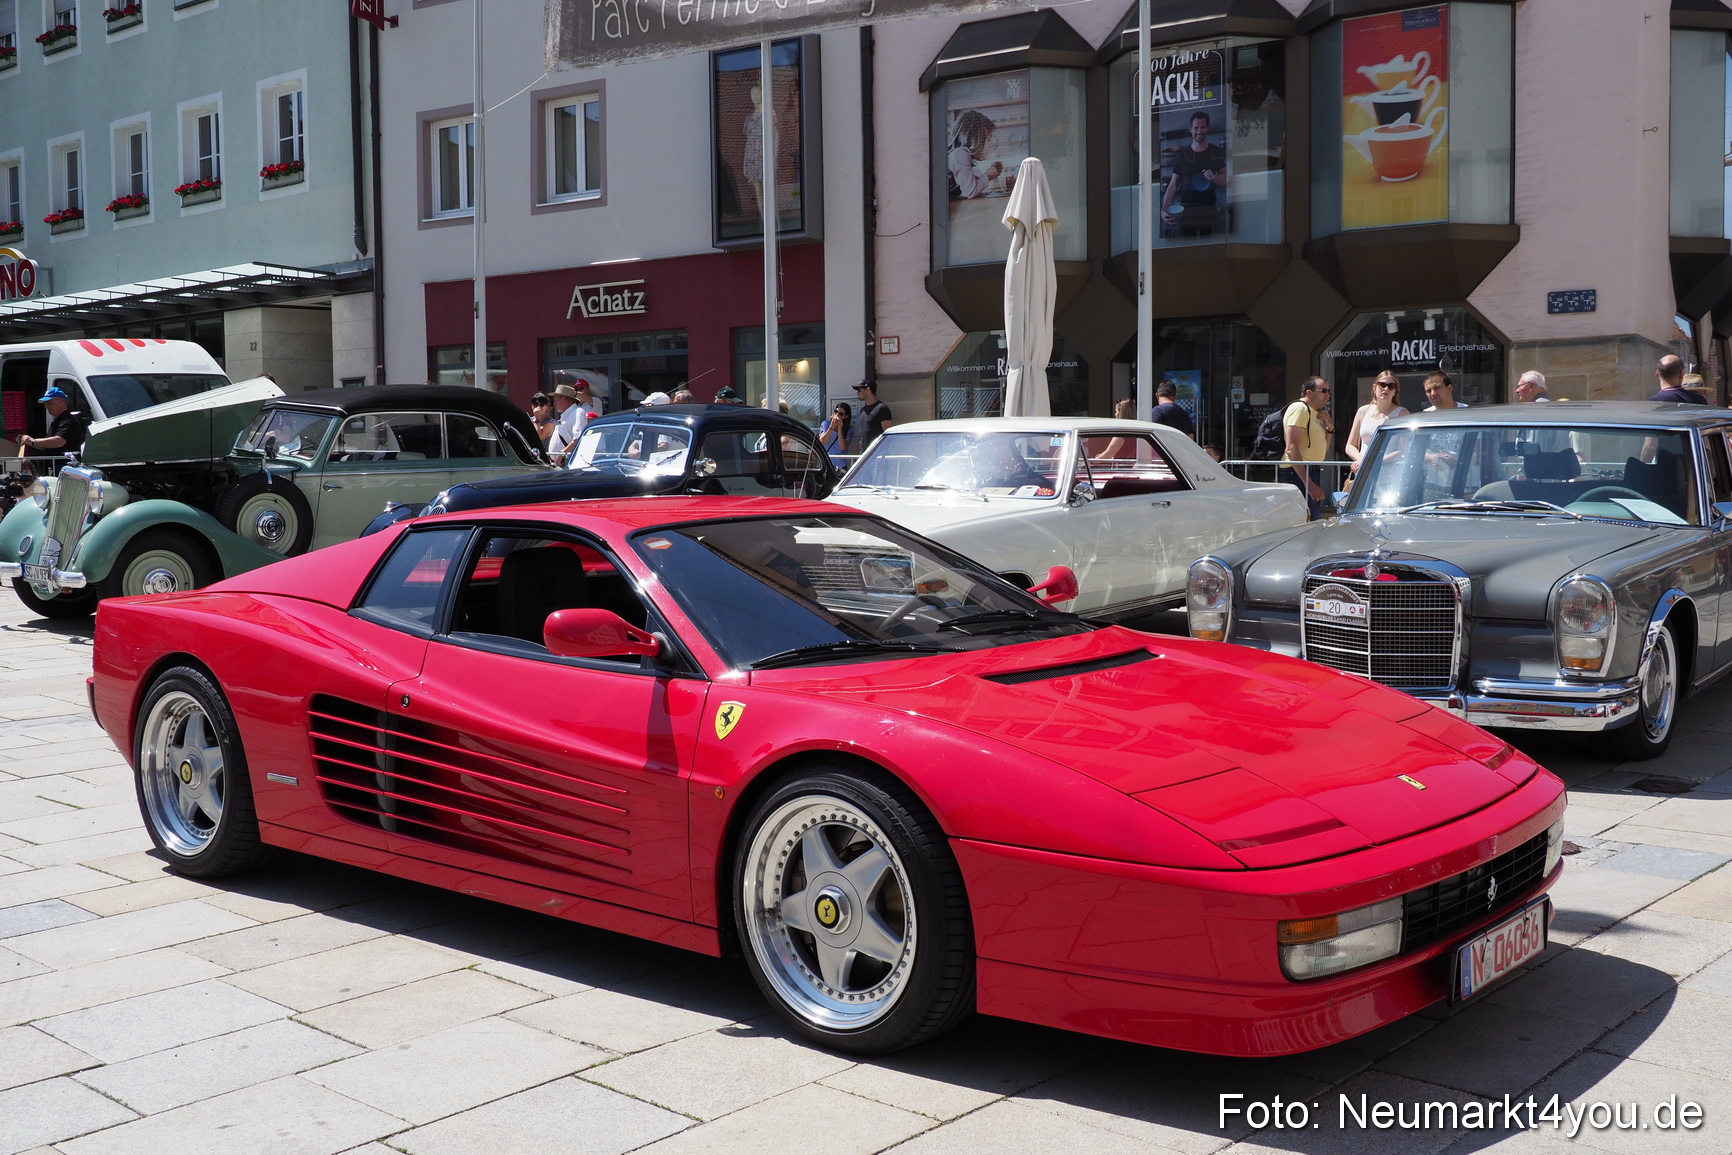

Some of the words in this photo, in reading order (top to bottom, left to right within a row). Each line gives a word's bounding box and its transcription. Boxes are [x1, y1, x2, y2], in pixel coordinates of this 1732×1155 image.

[1151, 58, 1167, 73] 00
[1170, 48, 1210, 71] Jahre
[1151, 70, 1199, 106] ACKL
[566, 279, 646, 320] Achatz
[249, 341, 258, 351] 22
[1326, 350, 1377, 359] Willkommen
[1378, 348, 1389, 356] im
[1391, 339, 1437, 361] RACKL
[779, 363, 797, 374] hatz
[946, 364, 986, 373] Willkommen
[1328, 601, 1341, 614] 20
[1464, 976, 1469, 987] D
[1472, 943, 1485, 986] N
